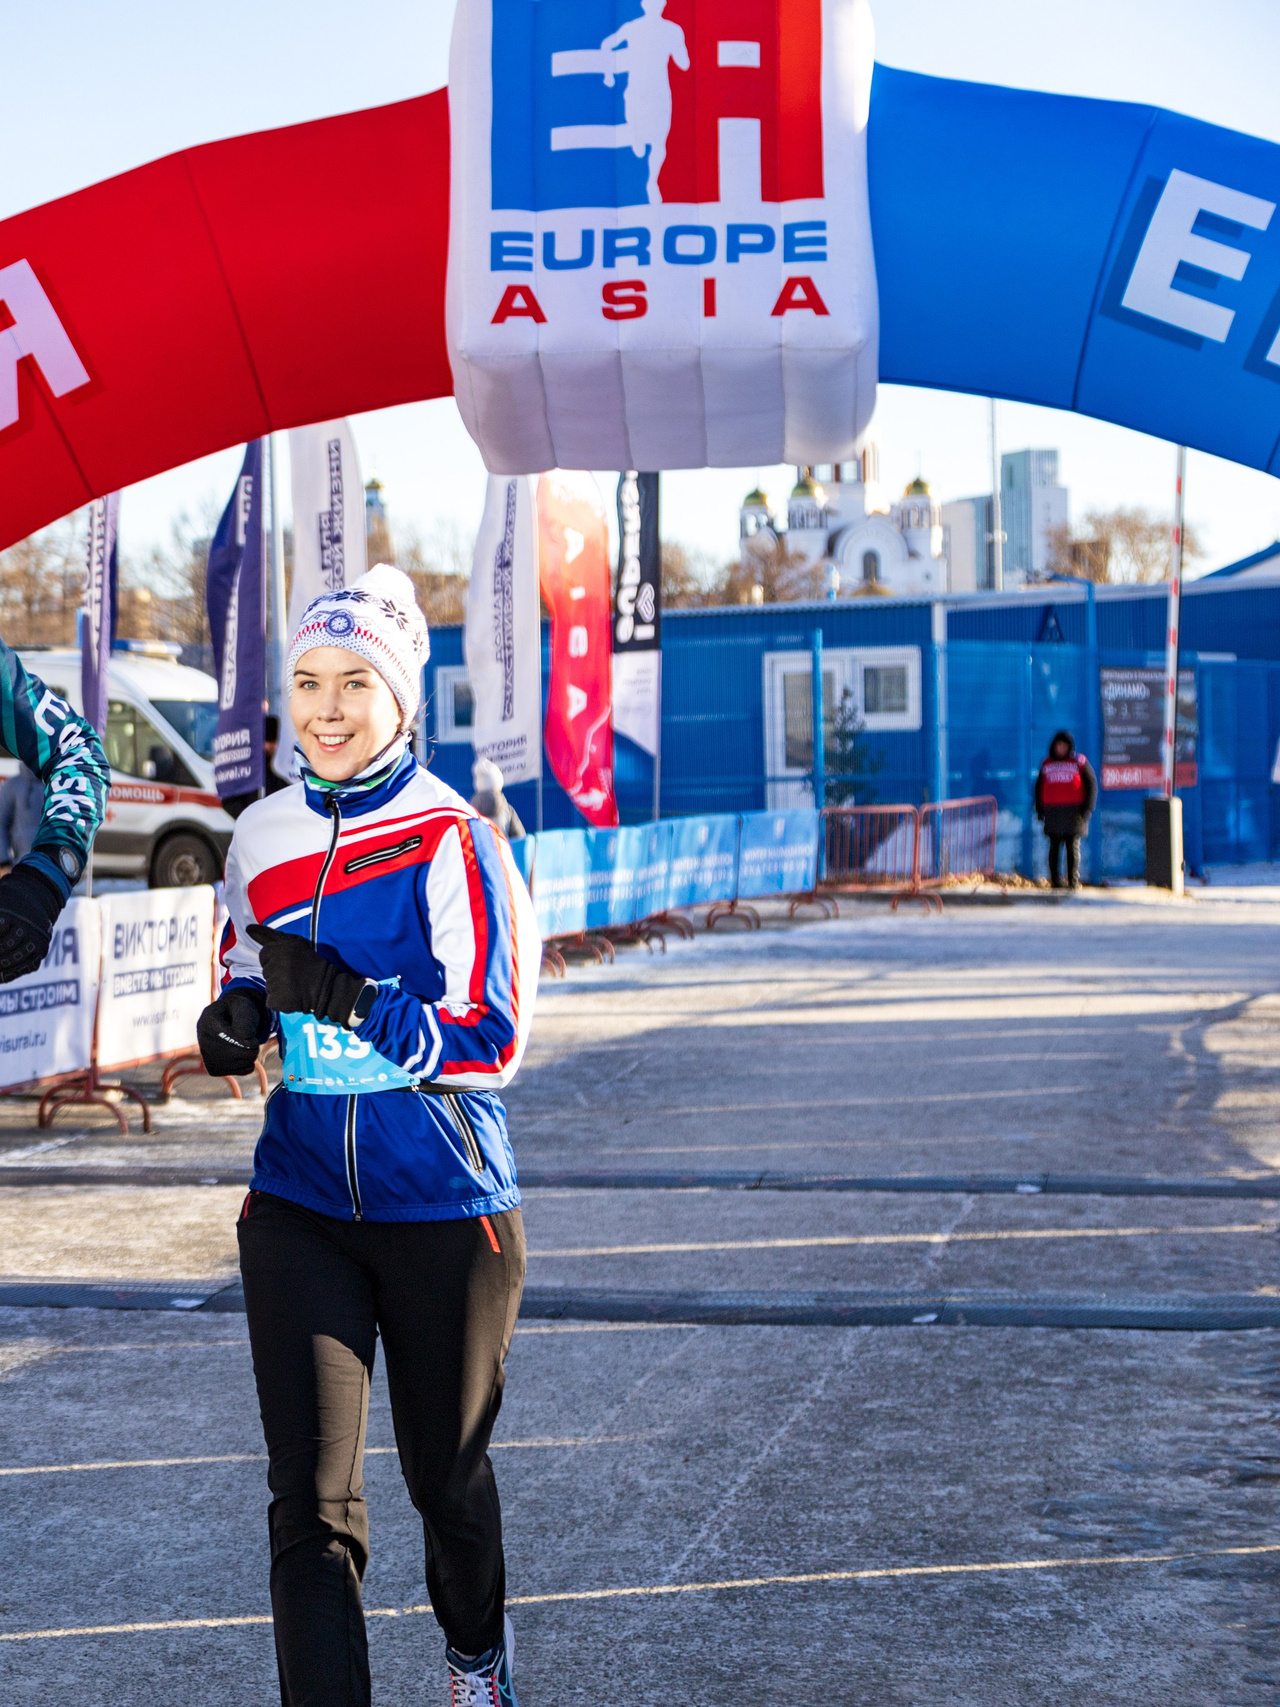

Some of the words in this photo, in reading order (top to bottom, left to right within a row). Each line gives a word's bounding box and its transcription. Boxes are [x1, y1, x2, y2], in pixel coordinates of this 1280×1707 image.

[490, 220, 827, 272] EUROPE
[490, 275, 831, 324] ASIA
[114, 914, 198, 959] ВИКТОРИЯ
